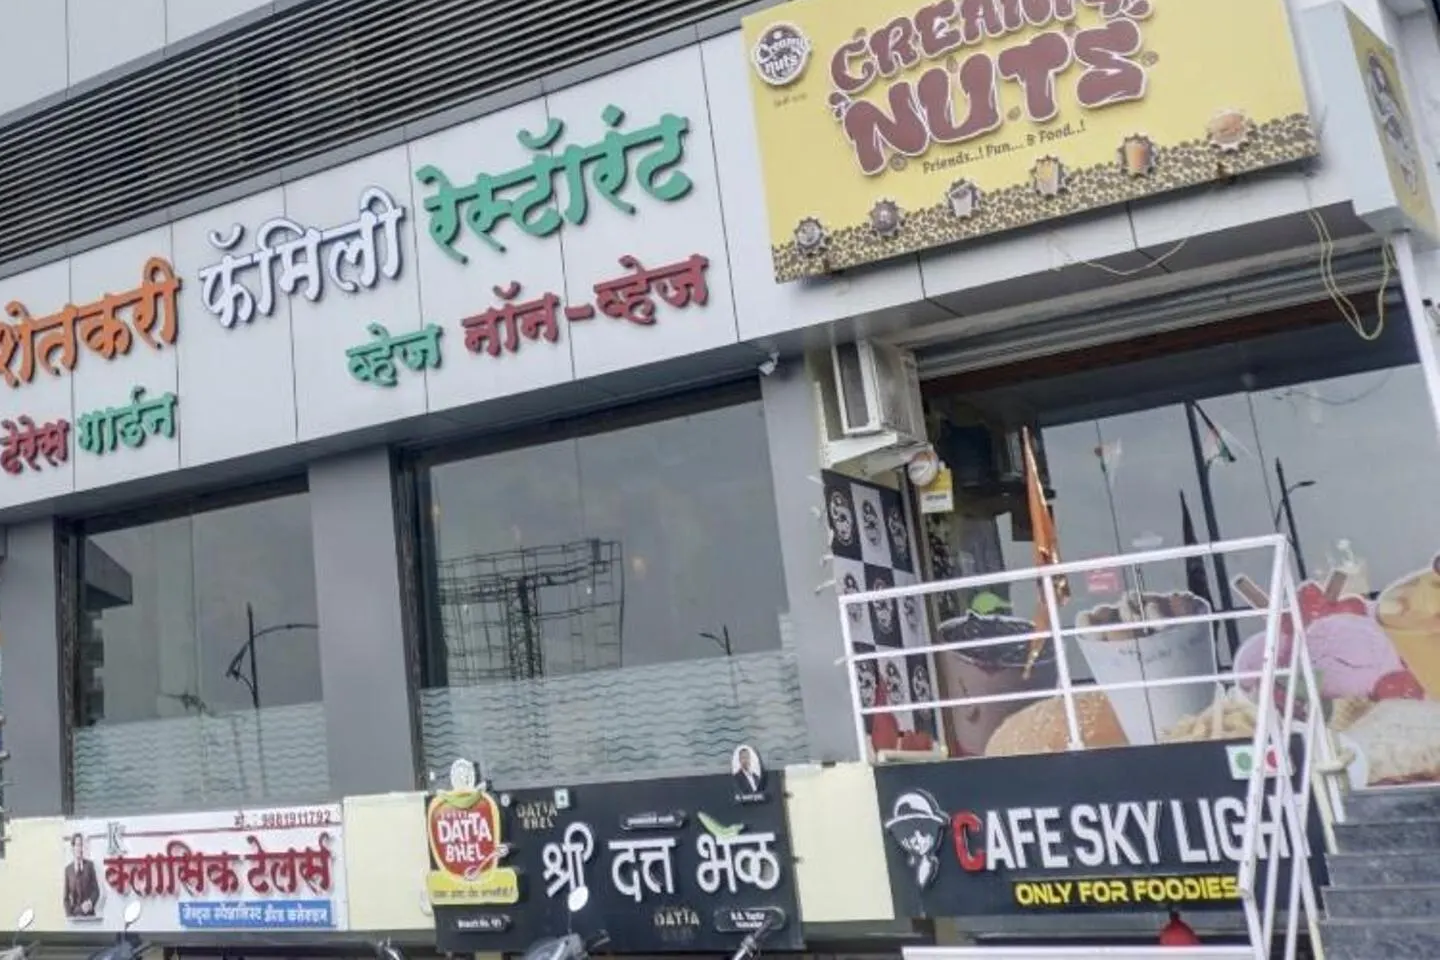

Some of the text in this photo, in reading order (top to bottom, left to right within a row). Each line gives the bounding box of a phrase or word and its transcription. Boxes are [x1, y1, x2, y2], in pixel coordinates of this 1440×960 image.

[841, 16, 1148, 176] NUTS
[198, 183, 406, 329] फॅमिली
[415, 104, 694, 265] रेस्टॉरंट
[345, 322, 445, 388] व्हेज
[0, 386, 180, 475] टेरेस गार्डन
[437, 812, 493, 843] DATTA
[445, 842, 485, 863] BHEL
[952, 806, 1069, 872] CAFE
[1070, 799, 1162, 867] SKY
[104, 832, 336, 897] क्लासिक टेलर्स
[542, 821, 594, 913] श्री
[608, 837, 676, 903] दत्त
[1015, 876, 1241, 907] ONLY FOR FOODIES
